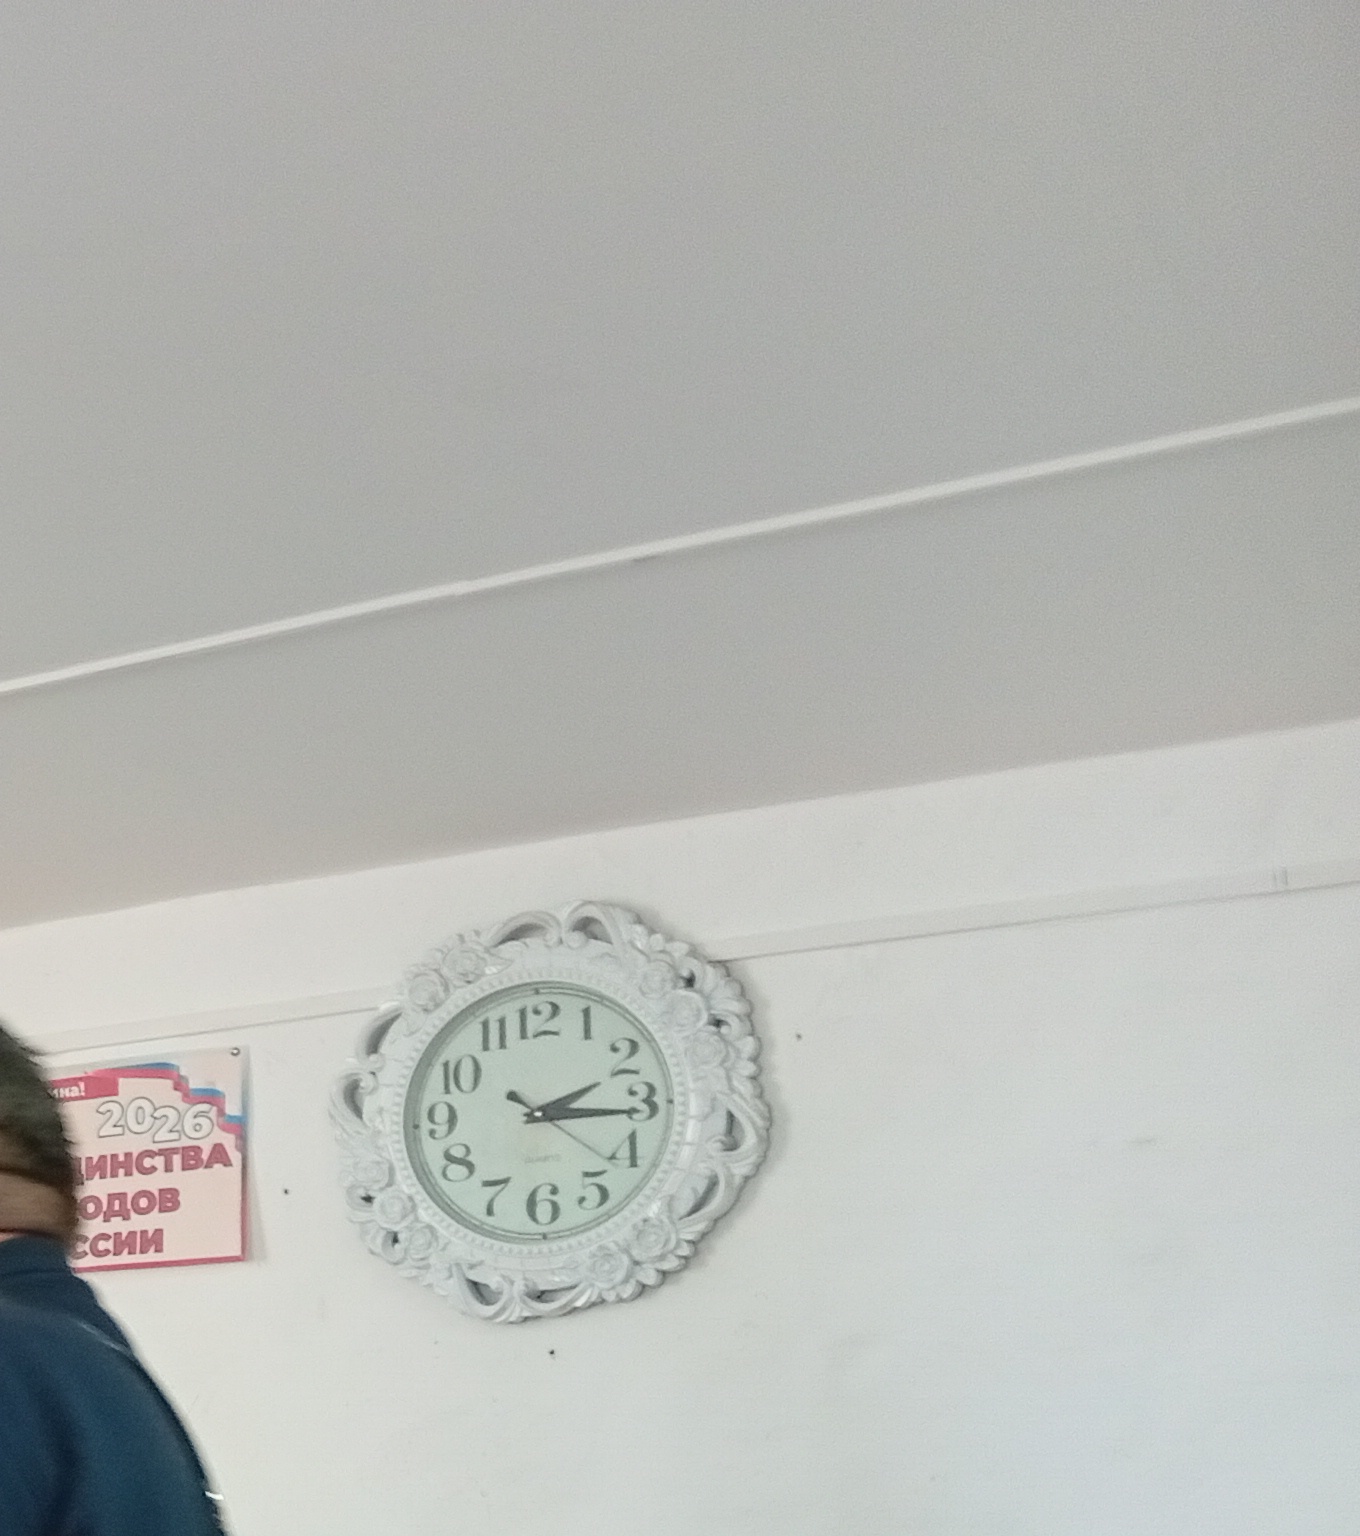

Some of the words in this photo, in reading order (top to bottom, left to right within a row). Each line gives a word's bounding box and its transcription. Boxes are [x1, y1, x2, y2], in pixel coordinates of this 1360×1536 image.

[480, 1016, 508, 1052] 11
[518, 1001, 561, 1040] 12
[581, 1005, 592, 1041] 1
[441, 1054, 483, 1095] 10
[609, 1037, 640, 1078] 2
[96, 1096, 214, 1144] 2026
[426, 1101, 459, 1141] 9
[626, 1081, 660, 1122] 3
[441, 1142, 476, 1183] 8
[608, 1129, 643, 1169] 4
[480, 1176, 512, 1217] 7
[525, 1182, 562, 1226] 6
[576, 1169, 611, 1211] 5
